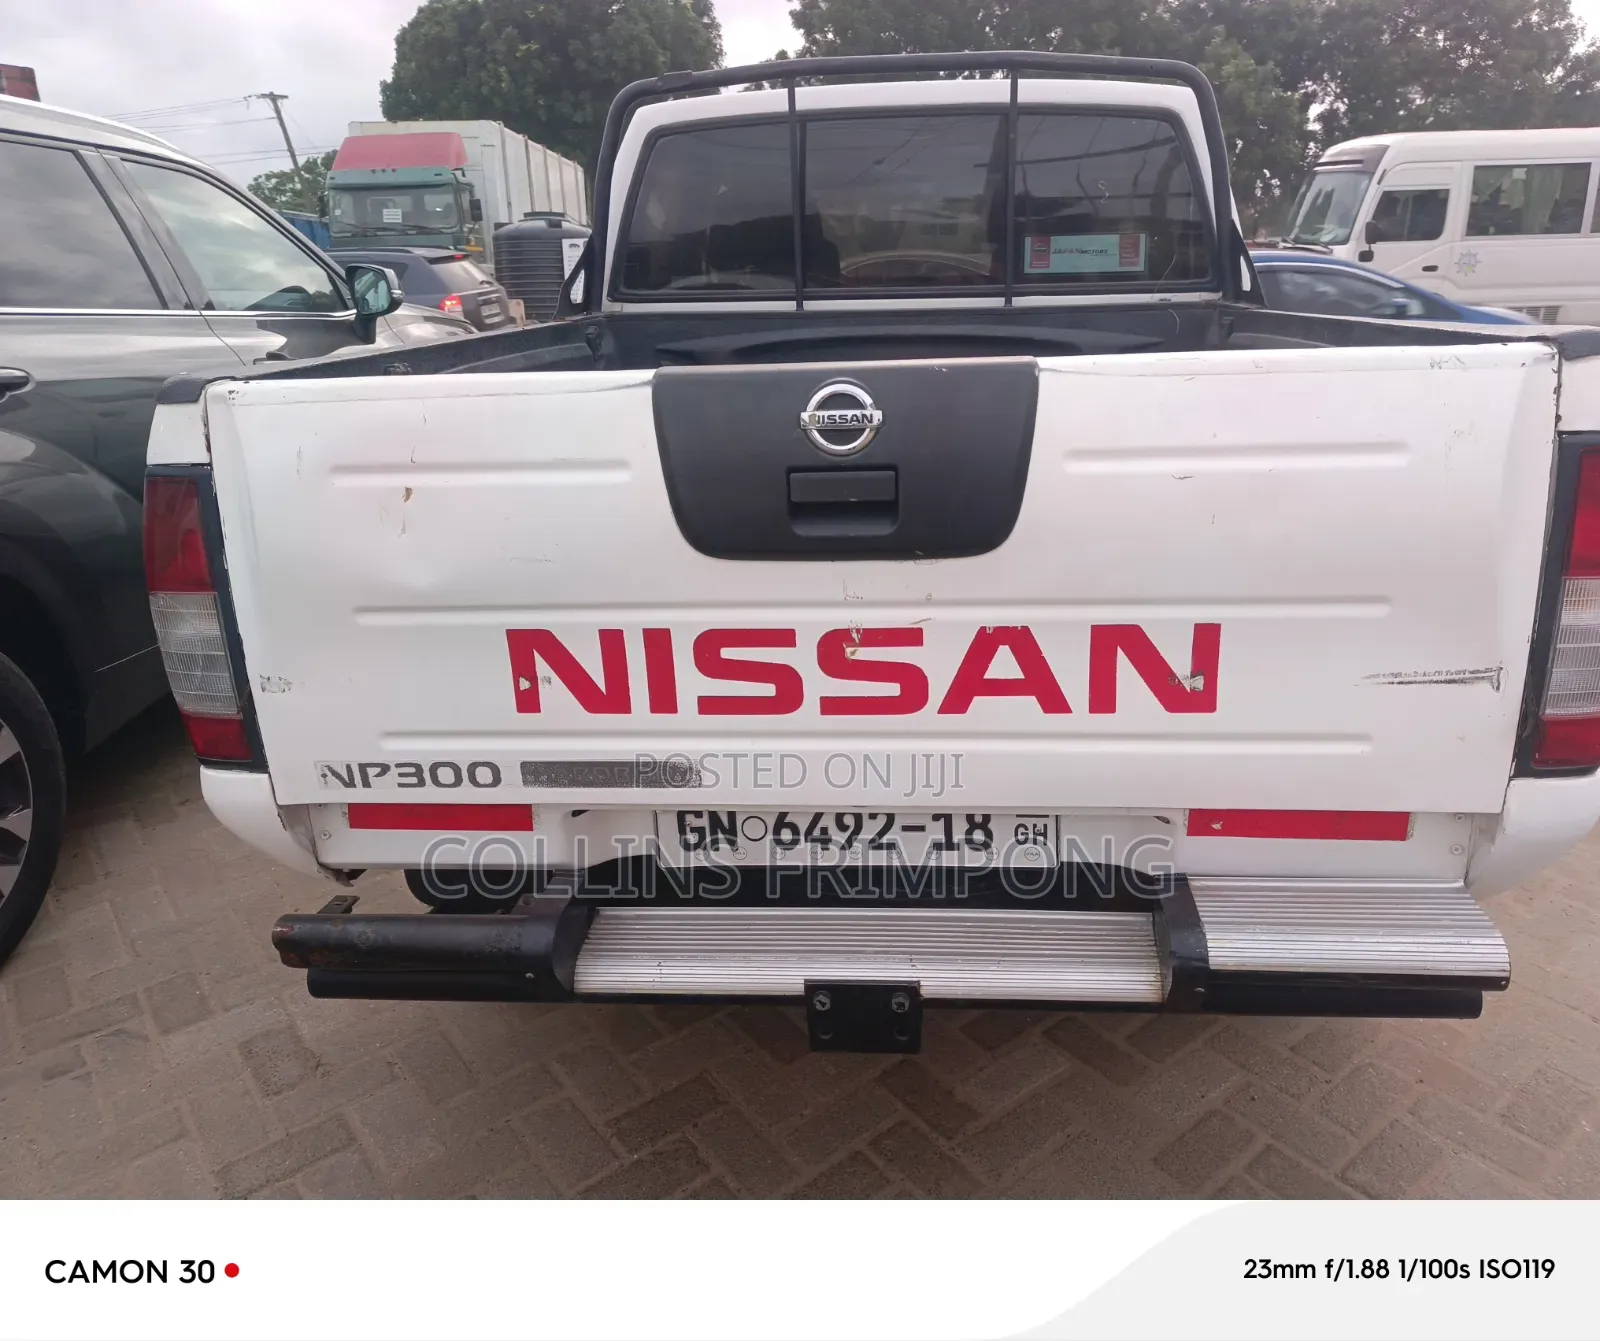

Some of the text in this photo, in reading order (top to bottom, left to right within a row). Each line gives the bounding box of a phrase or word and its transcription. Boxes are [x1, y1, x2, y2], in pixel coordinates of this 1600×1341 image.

[505, 623, 1222, 716] NISSAN
[321, 761, 502, 789] NP300
[676, 810, 739, 852] GN
[1014, 823, 1048, 847] GH
